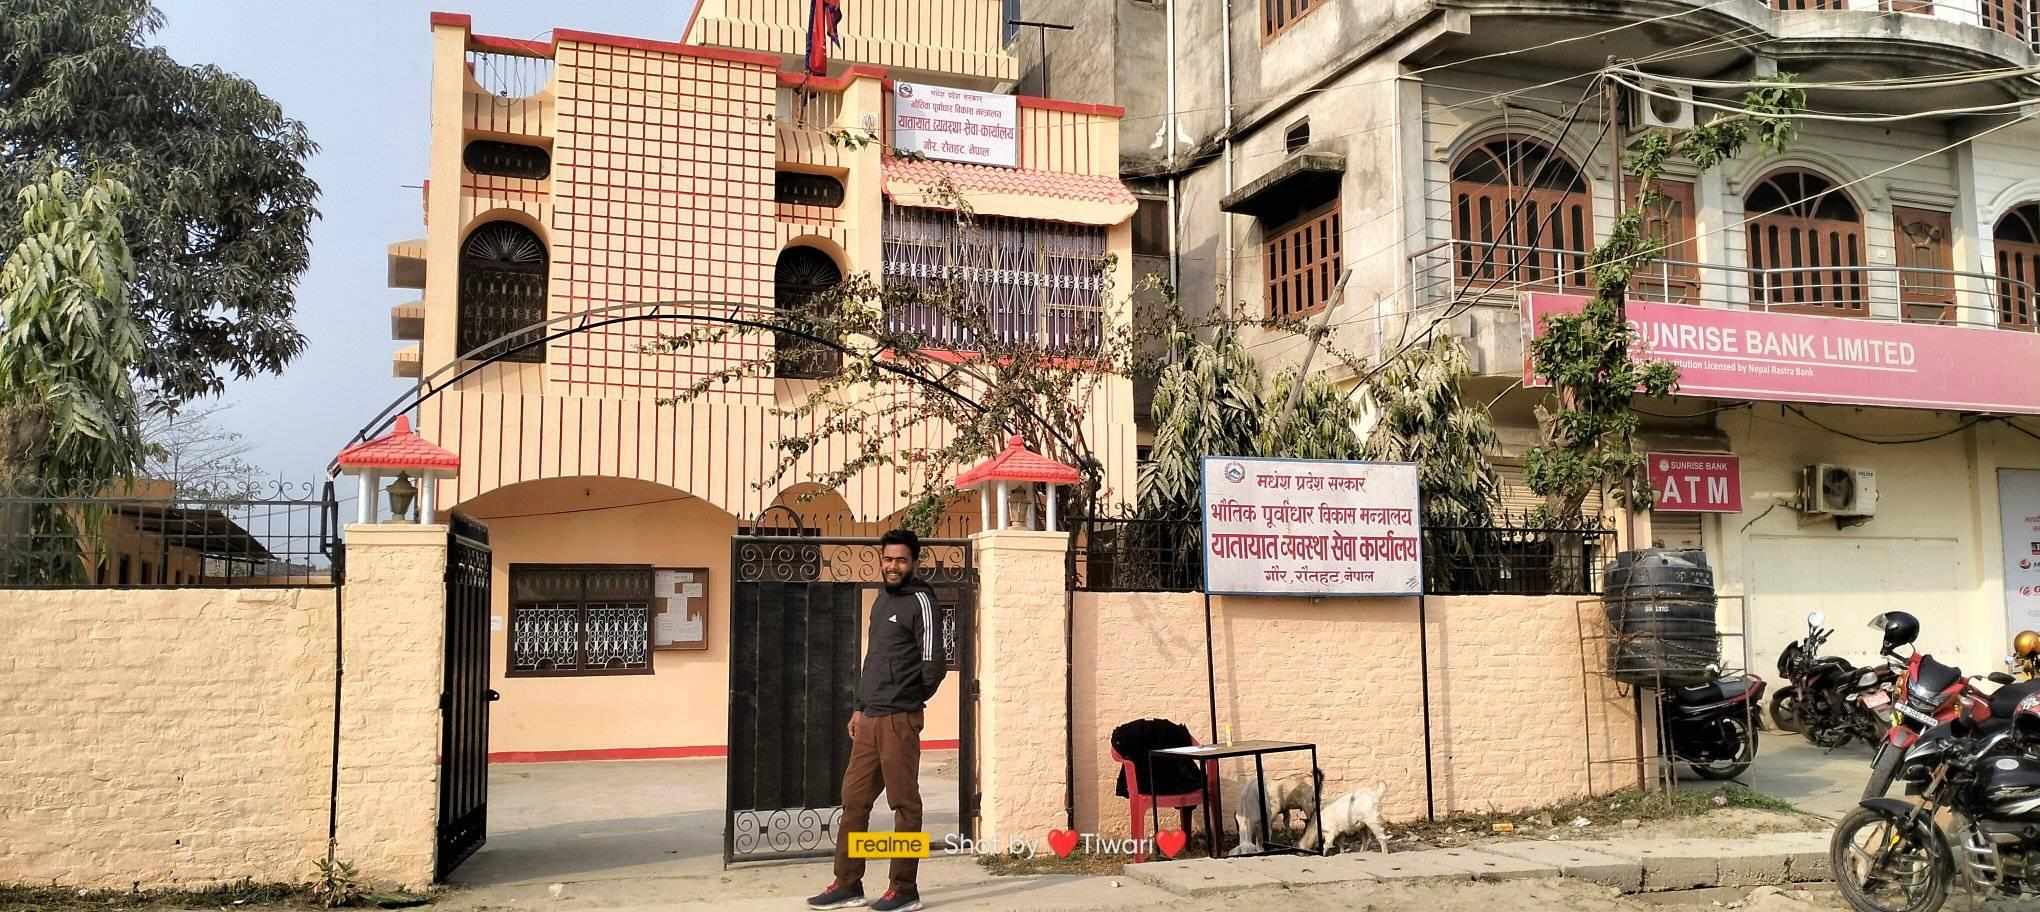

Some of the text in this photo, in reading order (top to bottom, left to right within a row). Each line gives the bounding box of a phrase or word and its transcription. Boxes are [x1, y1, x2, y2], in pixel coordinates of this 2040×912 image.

[898, 115, 1014, 140] यातायात व्यवस्था सेवा कार्यालय
[1625, 320, 1916, 366] SUNRISE BANK LIMITED
[1670, 461, 1728, 471] SUNRISE BANK
[1295, 471, 1325, 491] प्रदेश
[1328, 476, 1366, 493] सरकार
[1662, 475, 1729, 504] ATM
[1211, 498, 1413, 529] भौतिक पूर्वाधार विकास मन्त्रालय
[1211, 530, 1418, 562] यातायात व्यवस्था सेवा कार्यालय
[1344, 567, 1375, 583] नेपाल
